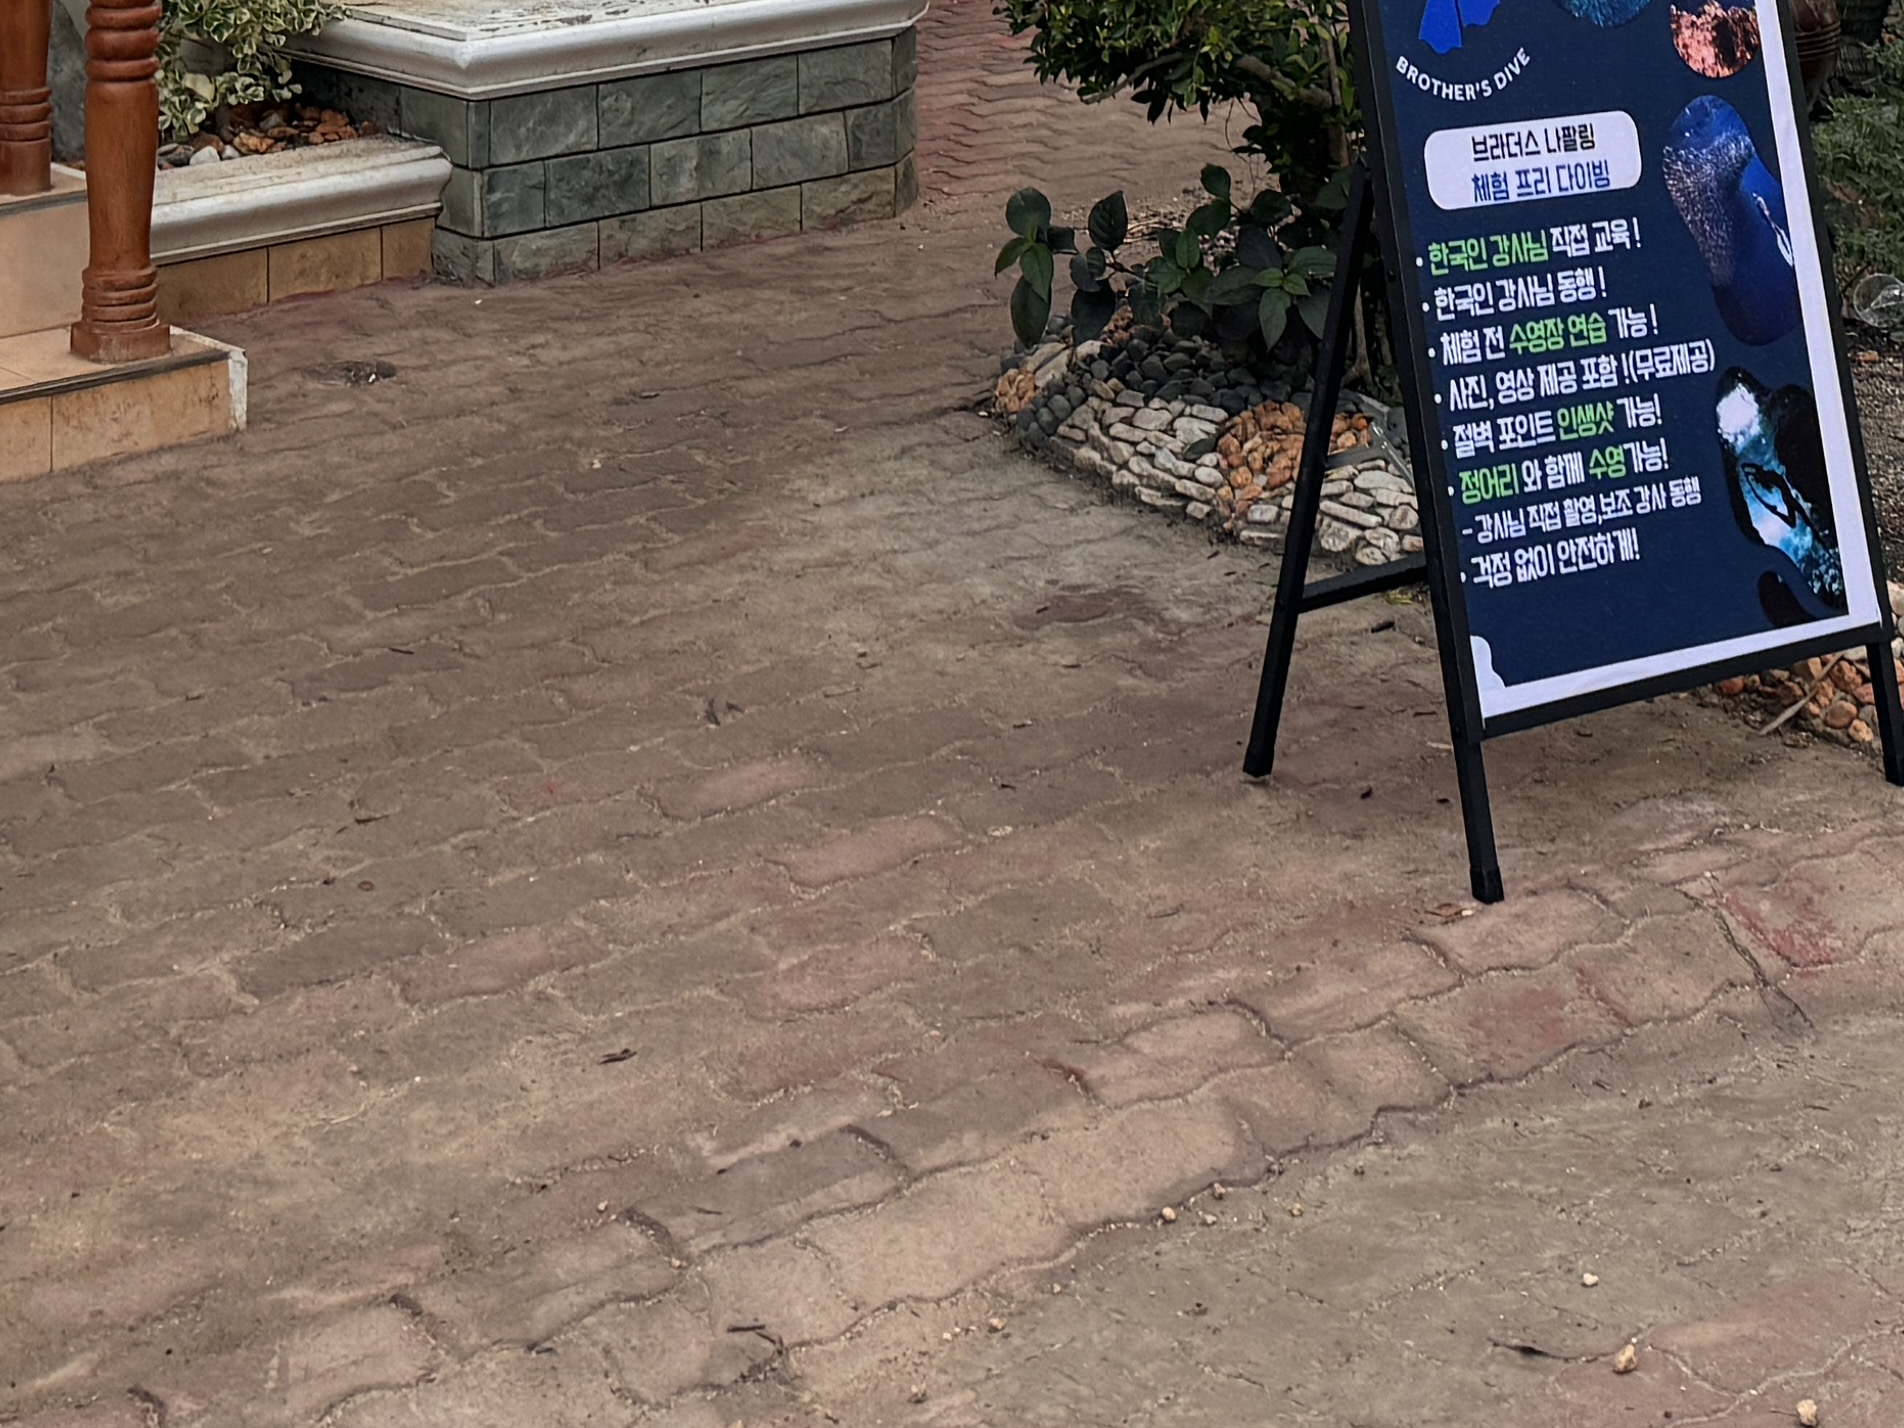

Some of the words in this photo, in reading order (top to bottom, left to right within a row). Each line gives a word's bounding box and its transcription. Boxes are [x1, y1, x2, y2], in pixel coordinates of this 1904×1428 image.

[1396, 55, 1492, 101] BROTHER'S
[1495, 46, 1531, 91] DIVE
[1471, 129, 1541, 162] 브라더스
[1544, 122, 1596, 154] 나팔링
[1471, 170, 1509, 204] 체험
[1515, 165, 1551, 198] 프리
[1555, 159, 1610, 192] 다이빙
[1428, 237, 1488, 276] 한국인
[1489, 229, 1549, 268] 강사님
[1550, 223, 1591, 258] 직접
[1434, 281, 1495, 322] 한국인
[1496, 273, 1555, 312] 강사님
[1440, 328, 1482, 366] 체험
[1483, 325, 1506, 361] 전
[1509, 317, 1566, 355] 수영장
[1567, 311, 1607, 347] 연습
[1496, 367, 1534, 405] 영상
[1537, 360, 1578, 397] 제공
[1496, 410, 1556, 450] 포인트
[1557, 401, 1615, 442] 인생샷
[1545, 450, 1585, 490] 함께
[1474, 507, 1526, 544] 강사님
[1527, 501, 1562, 533] 직접
[1634, 482, 1667, 515] 강사
[1669, 476, 1702, 508] 동행
[1471, 550, 1512, 589] 걱정
[1514, 544, 1556, 583] 없이
